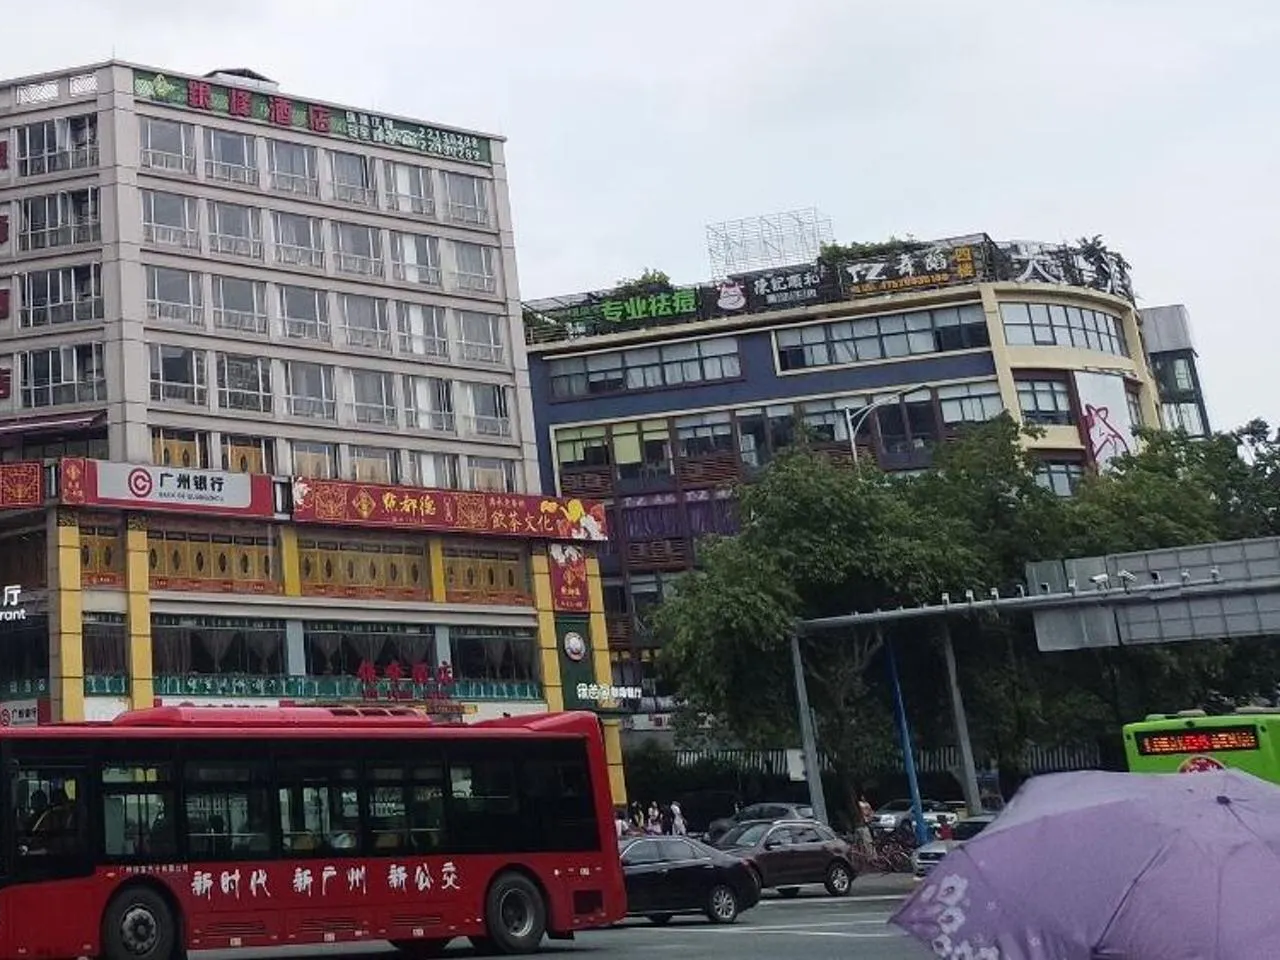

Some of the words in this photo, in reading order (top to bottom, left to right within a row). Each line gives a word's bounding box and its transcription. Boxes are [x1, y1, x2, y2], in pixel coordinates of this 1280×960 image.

[601, 287, 697, 323] 专业祛痘
[159, 473, 225, 492] 广州银行
[191, 869, 271, 899] 新时代
[292, 865, 367, 898] 新广州
[387, 861, 461, 891] 新公交
